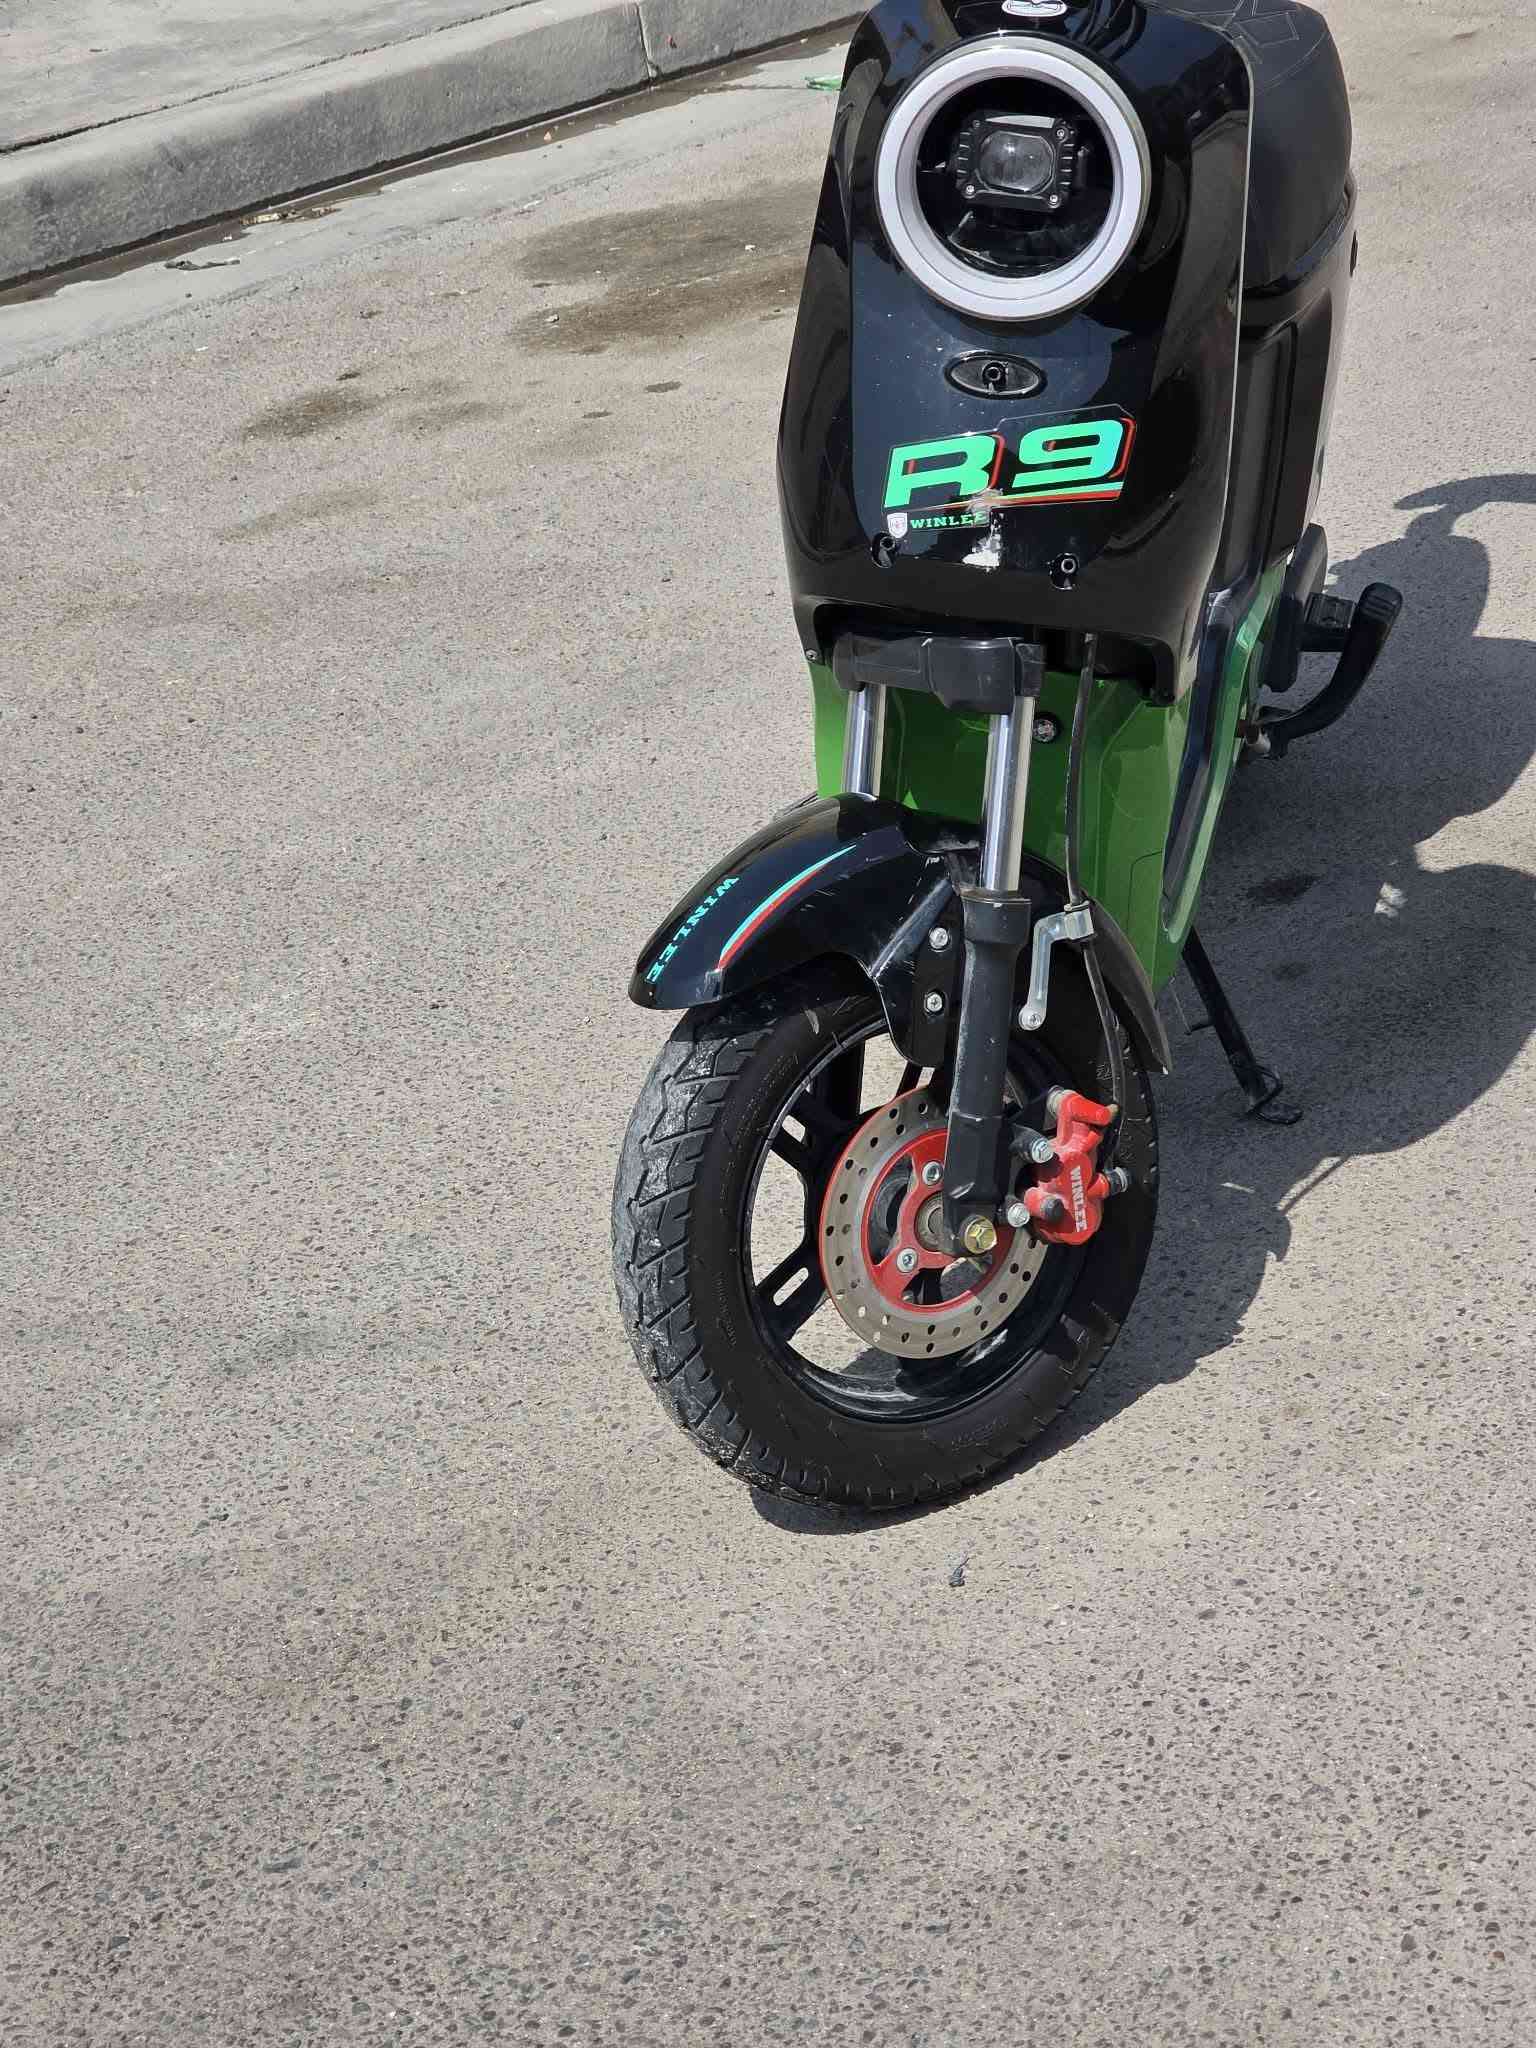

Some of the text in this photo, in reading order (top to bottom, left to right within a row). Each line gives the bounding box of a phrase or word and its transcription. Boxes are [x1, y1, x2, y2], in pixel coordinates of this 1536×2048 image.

[884, 419, 1130, 508] R9
[911, 510, 988, 529] WINLEE
[646, 877, 740, 982] WINLEE
[1070, 1165, 1088, 1233] WINLEE
